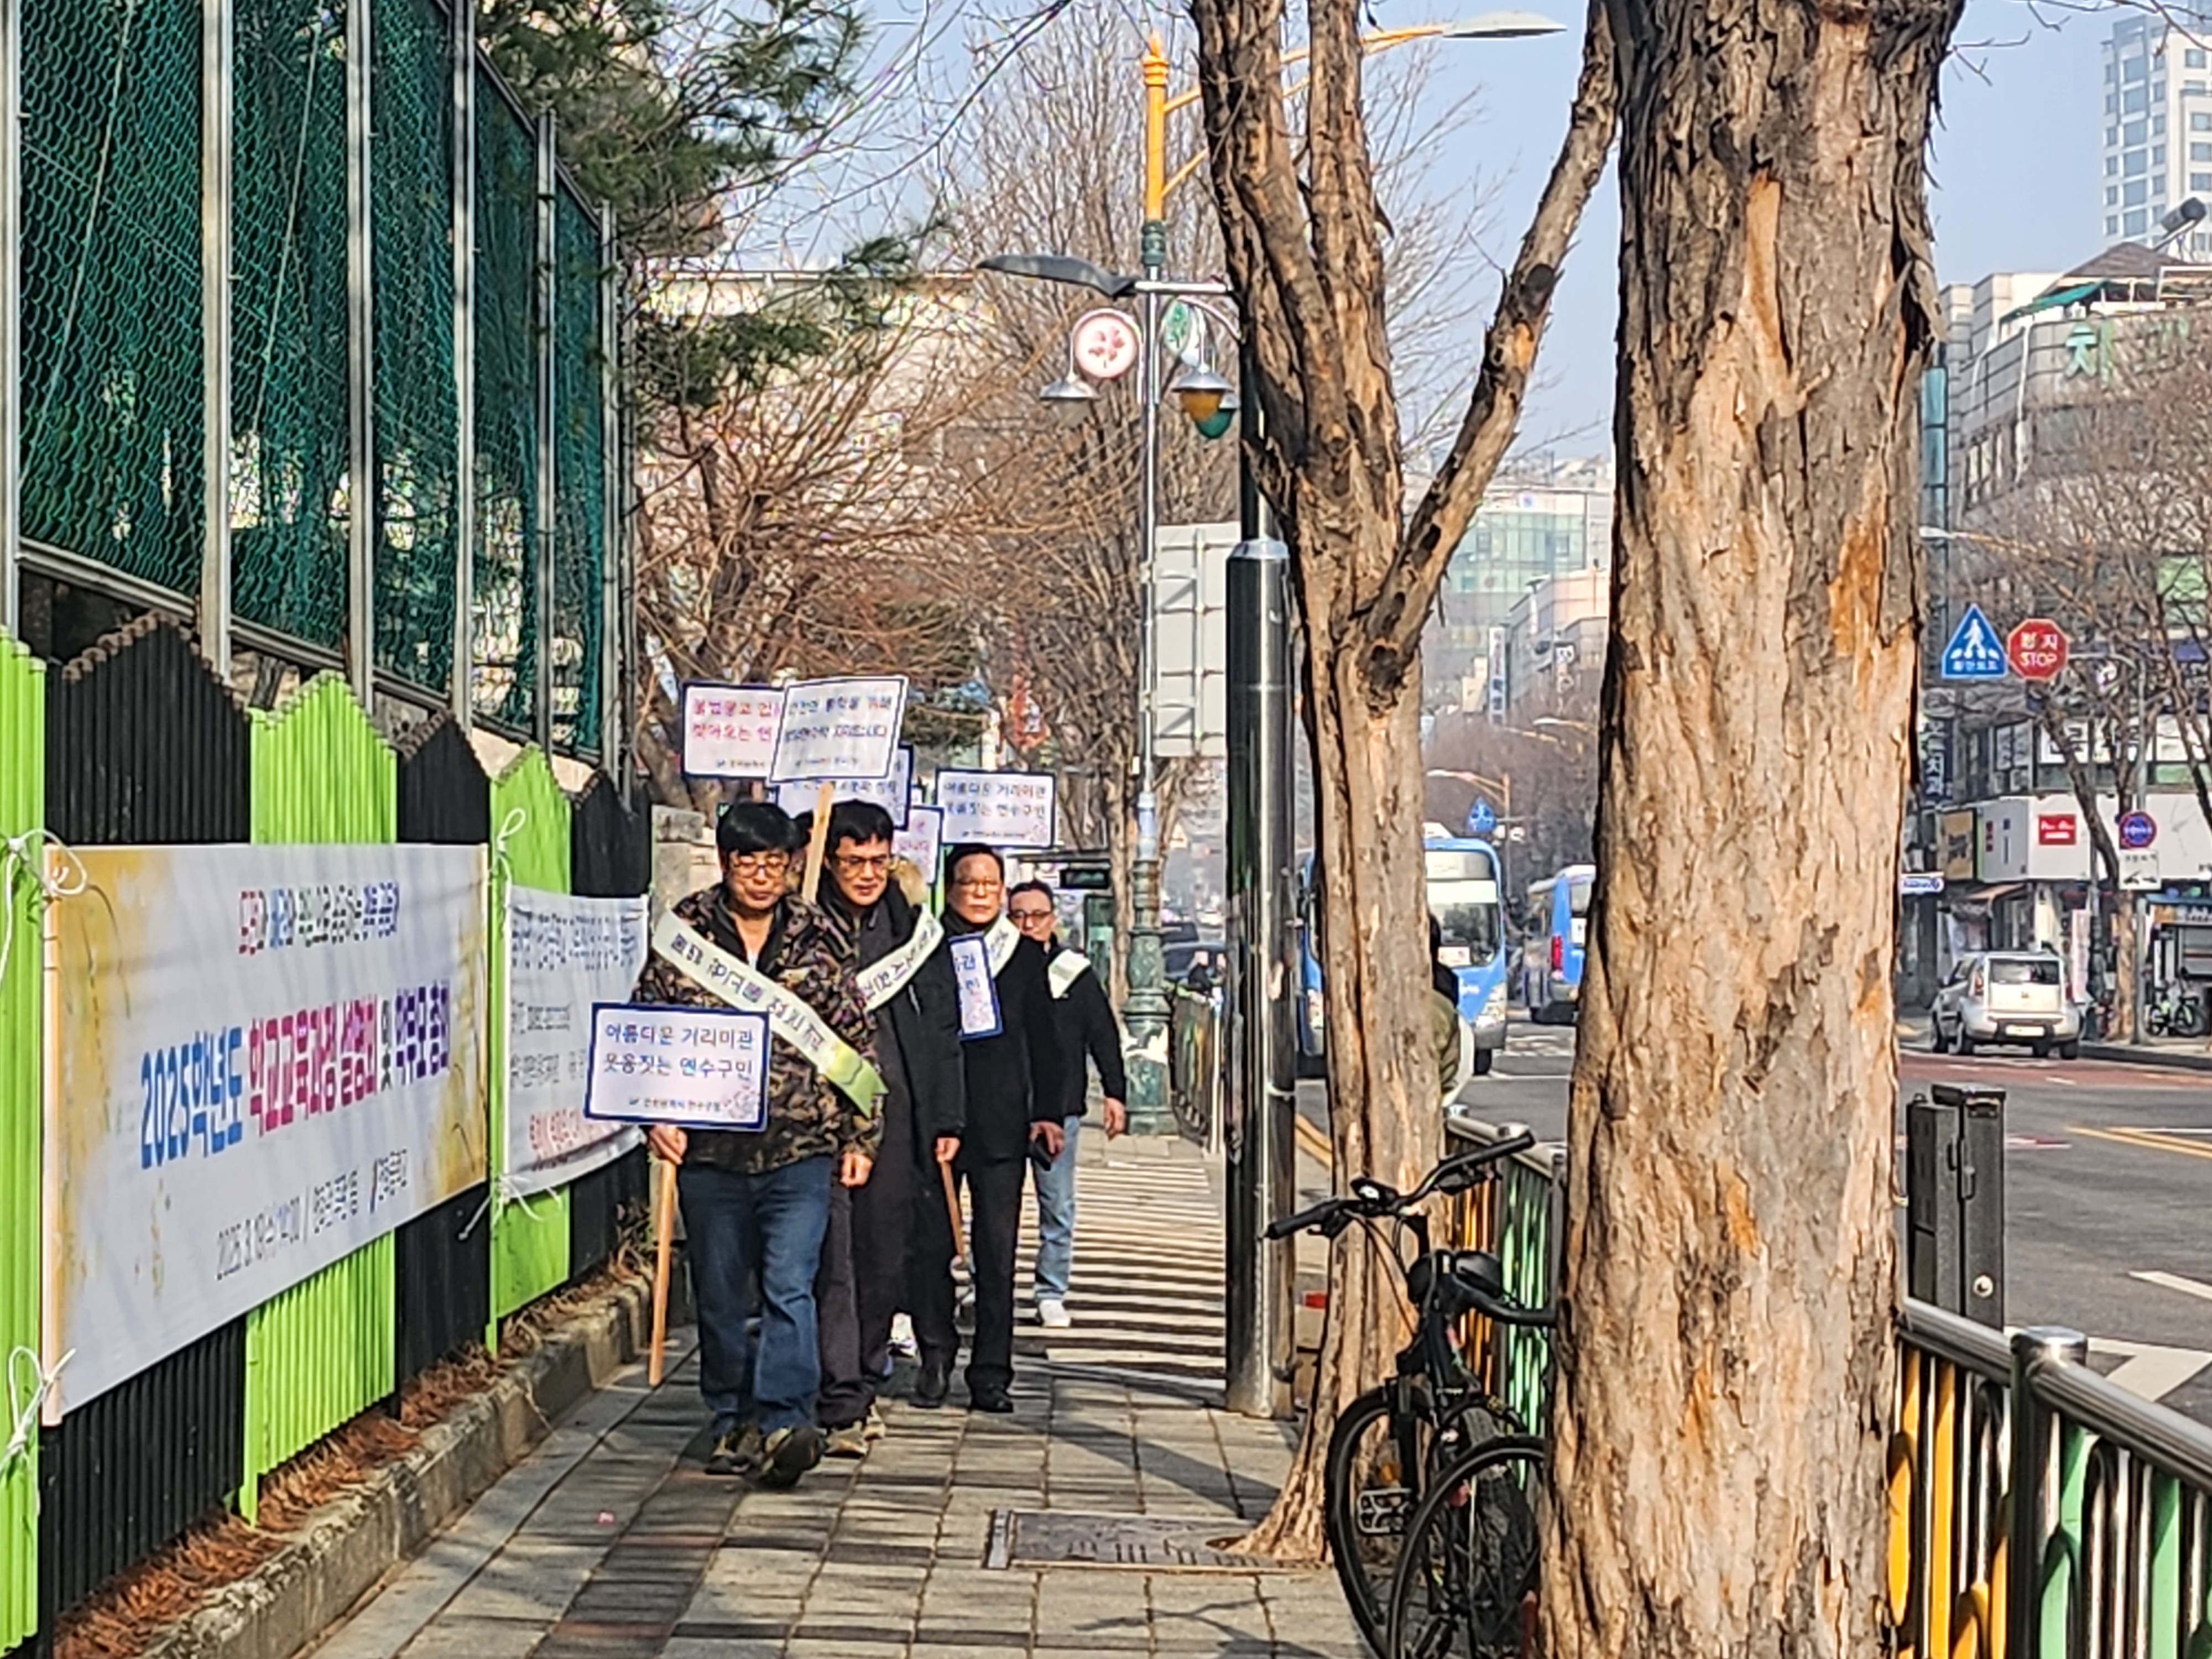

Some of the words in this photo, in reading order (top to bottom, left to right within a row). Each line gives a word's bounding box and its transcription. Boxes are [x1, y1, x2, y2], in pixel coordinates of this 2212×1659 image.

[2021, 632, 2058, 650] 정지
[2020, 651, 2058, 666] STOP
[605, 1023, 675, 1045] 아름다운
[681, 1027, 753, 1050] 거리미관
[603, 1052, 672, 1076] 웃음짓는
[680, 1057, 753, 1081] 연수구민
[141, 1026, 243, 1170] 2025학년도
